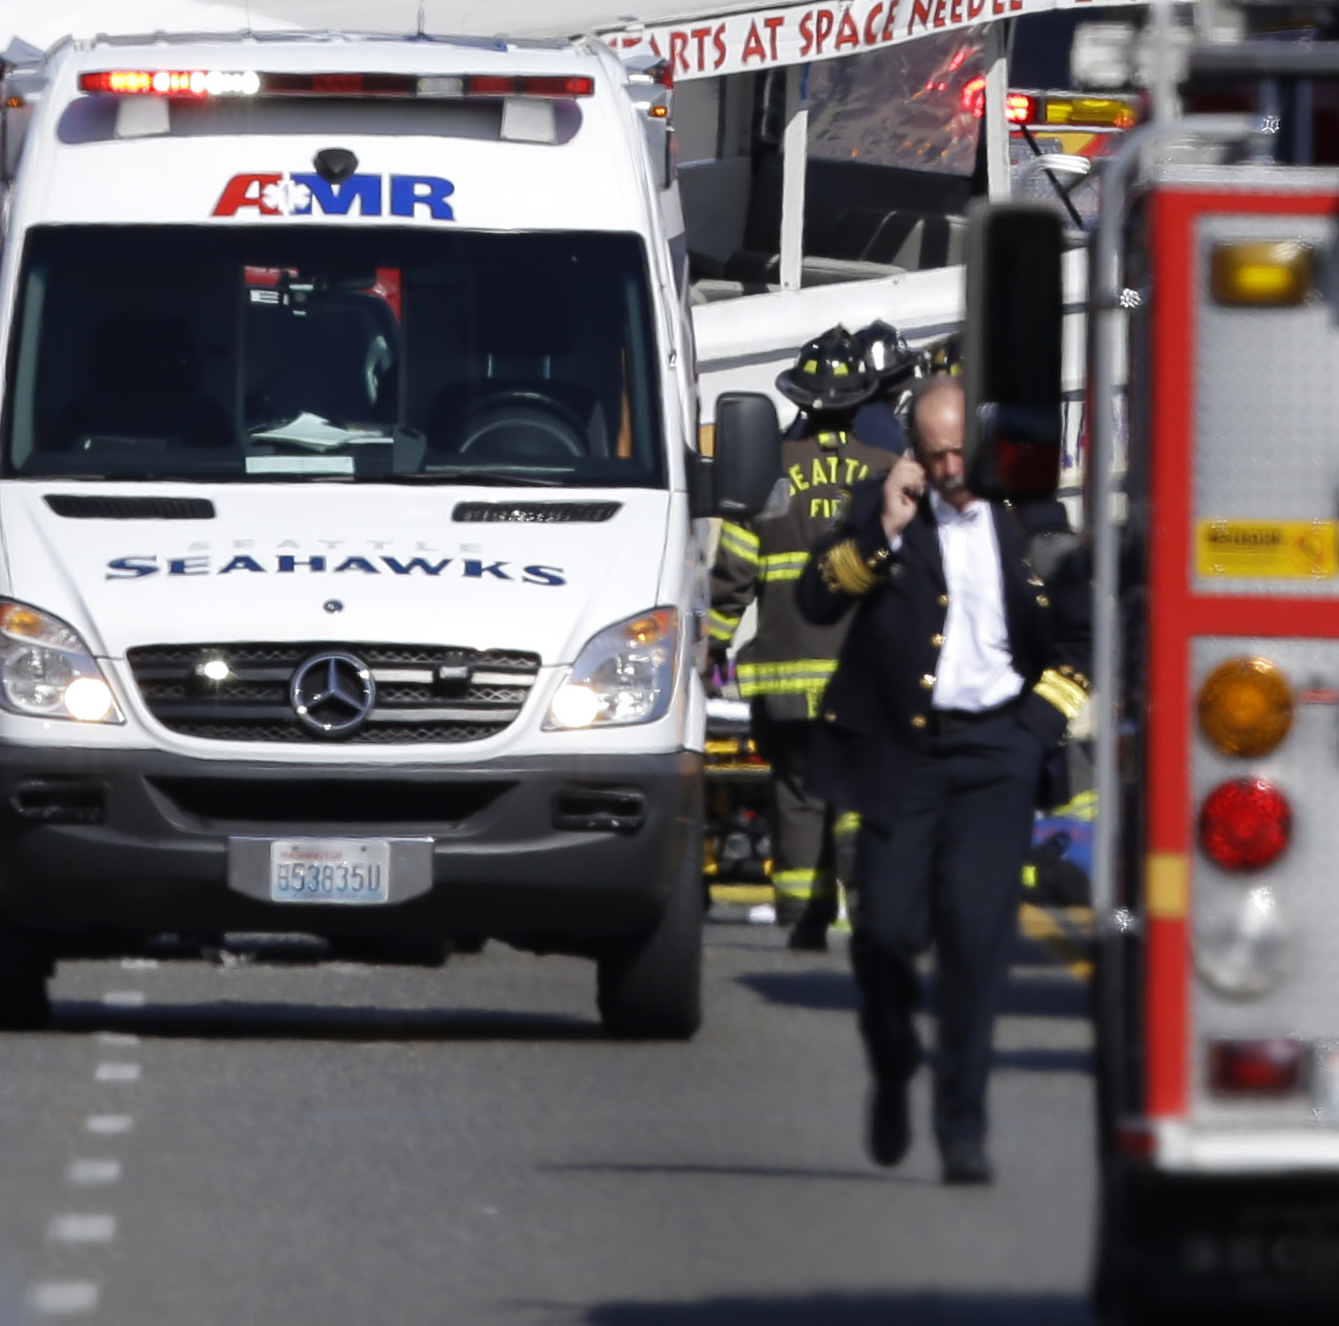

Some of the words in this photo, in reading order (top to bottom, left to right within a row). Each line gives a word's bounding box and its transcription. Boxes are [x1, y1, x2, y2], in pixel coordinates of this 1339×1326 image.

[741, 16, 785, 65] AT
[211, 172, 457, 221] AMR
[187, 538, 482, 554] SEATTLE
[104, 555, 569, 587] SEAHAWKS
